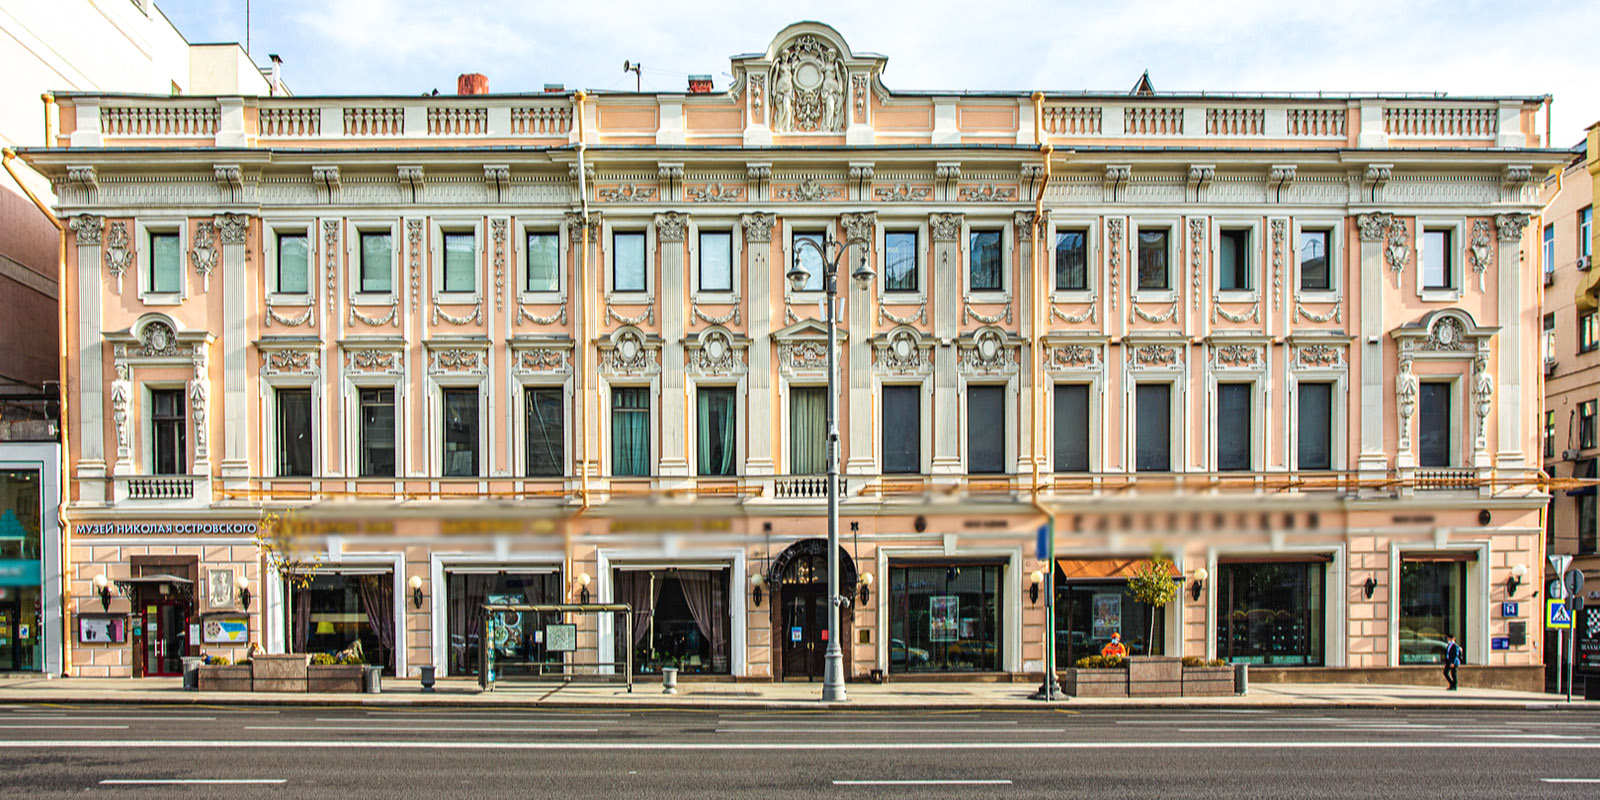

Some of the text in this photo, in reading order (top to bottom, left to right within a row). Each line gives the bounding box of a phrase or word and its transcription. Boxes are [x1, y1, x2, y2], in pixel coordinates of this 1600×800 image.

[76, 522, 257, 534] МУЗЕЙ НИКОЛАЯ ОСТРОВСКОГО
[1506, 606, 1515, 614] 14
